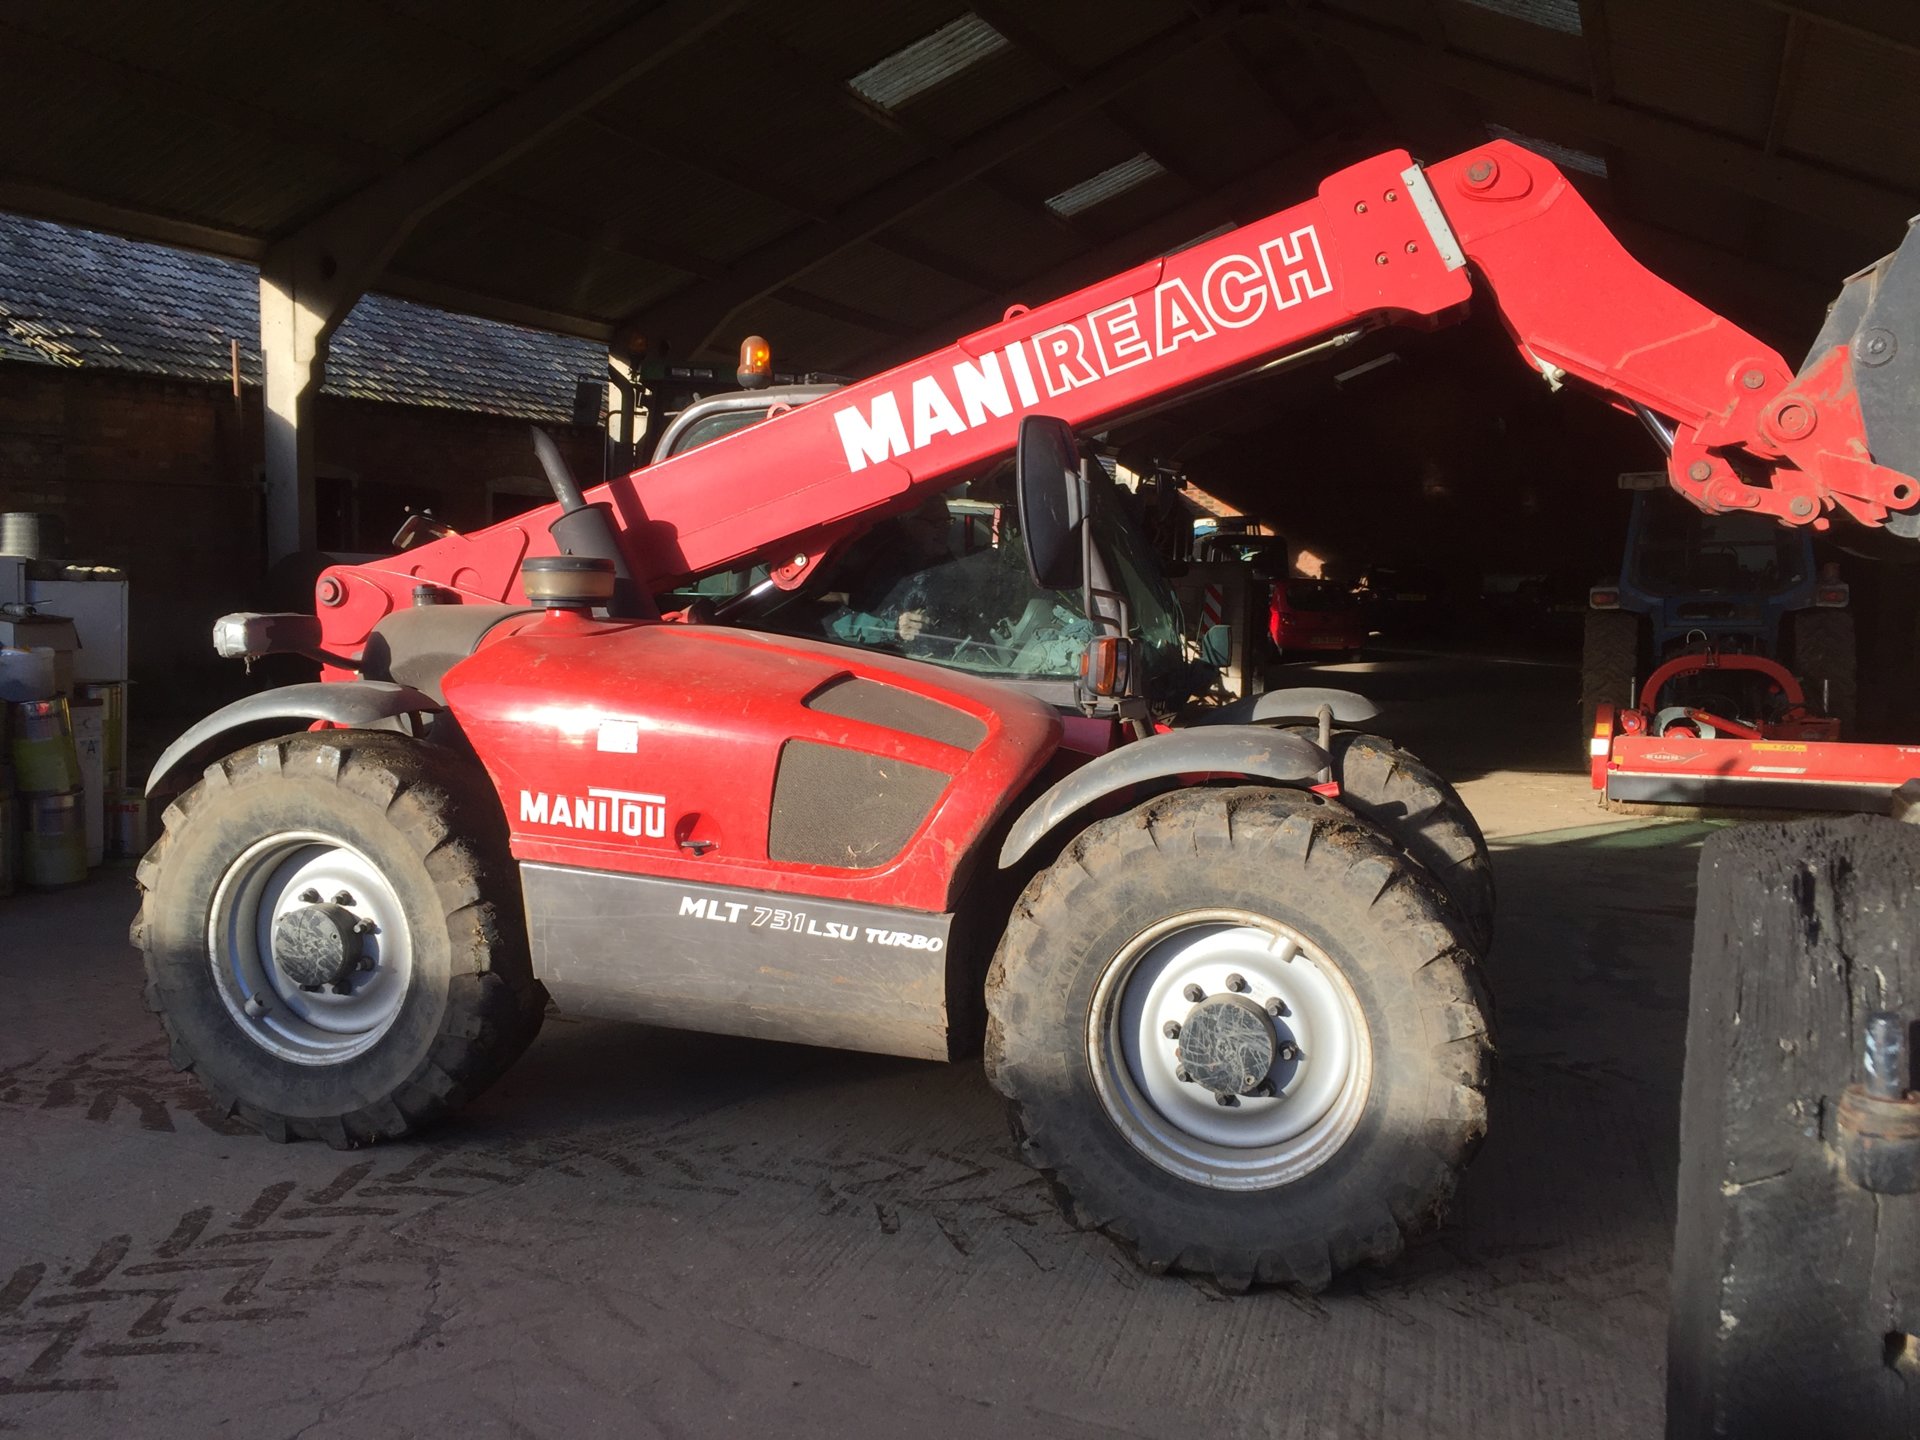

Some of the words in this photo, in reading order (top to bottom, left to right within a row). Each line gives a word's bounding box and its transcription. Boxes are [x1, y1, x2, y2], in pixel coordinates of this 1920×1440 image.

[833, 224, 1333, 473] MANIREACH
[520, 786, 666, 838] MANITOU
[679, 896, 748, 924] MLT
[752, 906, 806, 932] 731
[807, 920, 859, 941] LSU
[865, 927, 944, 953] TURBO
